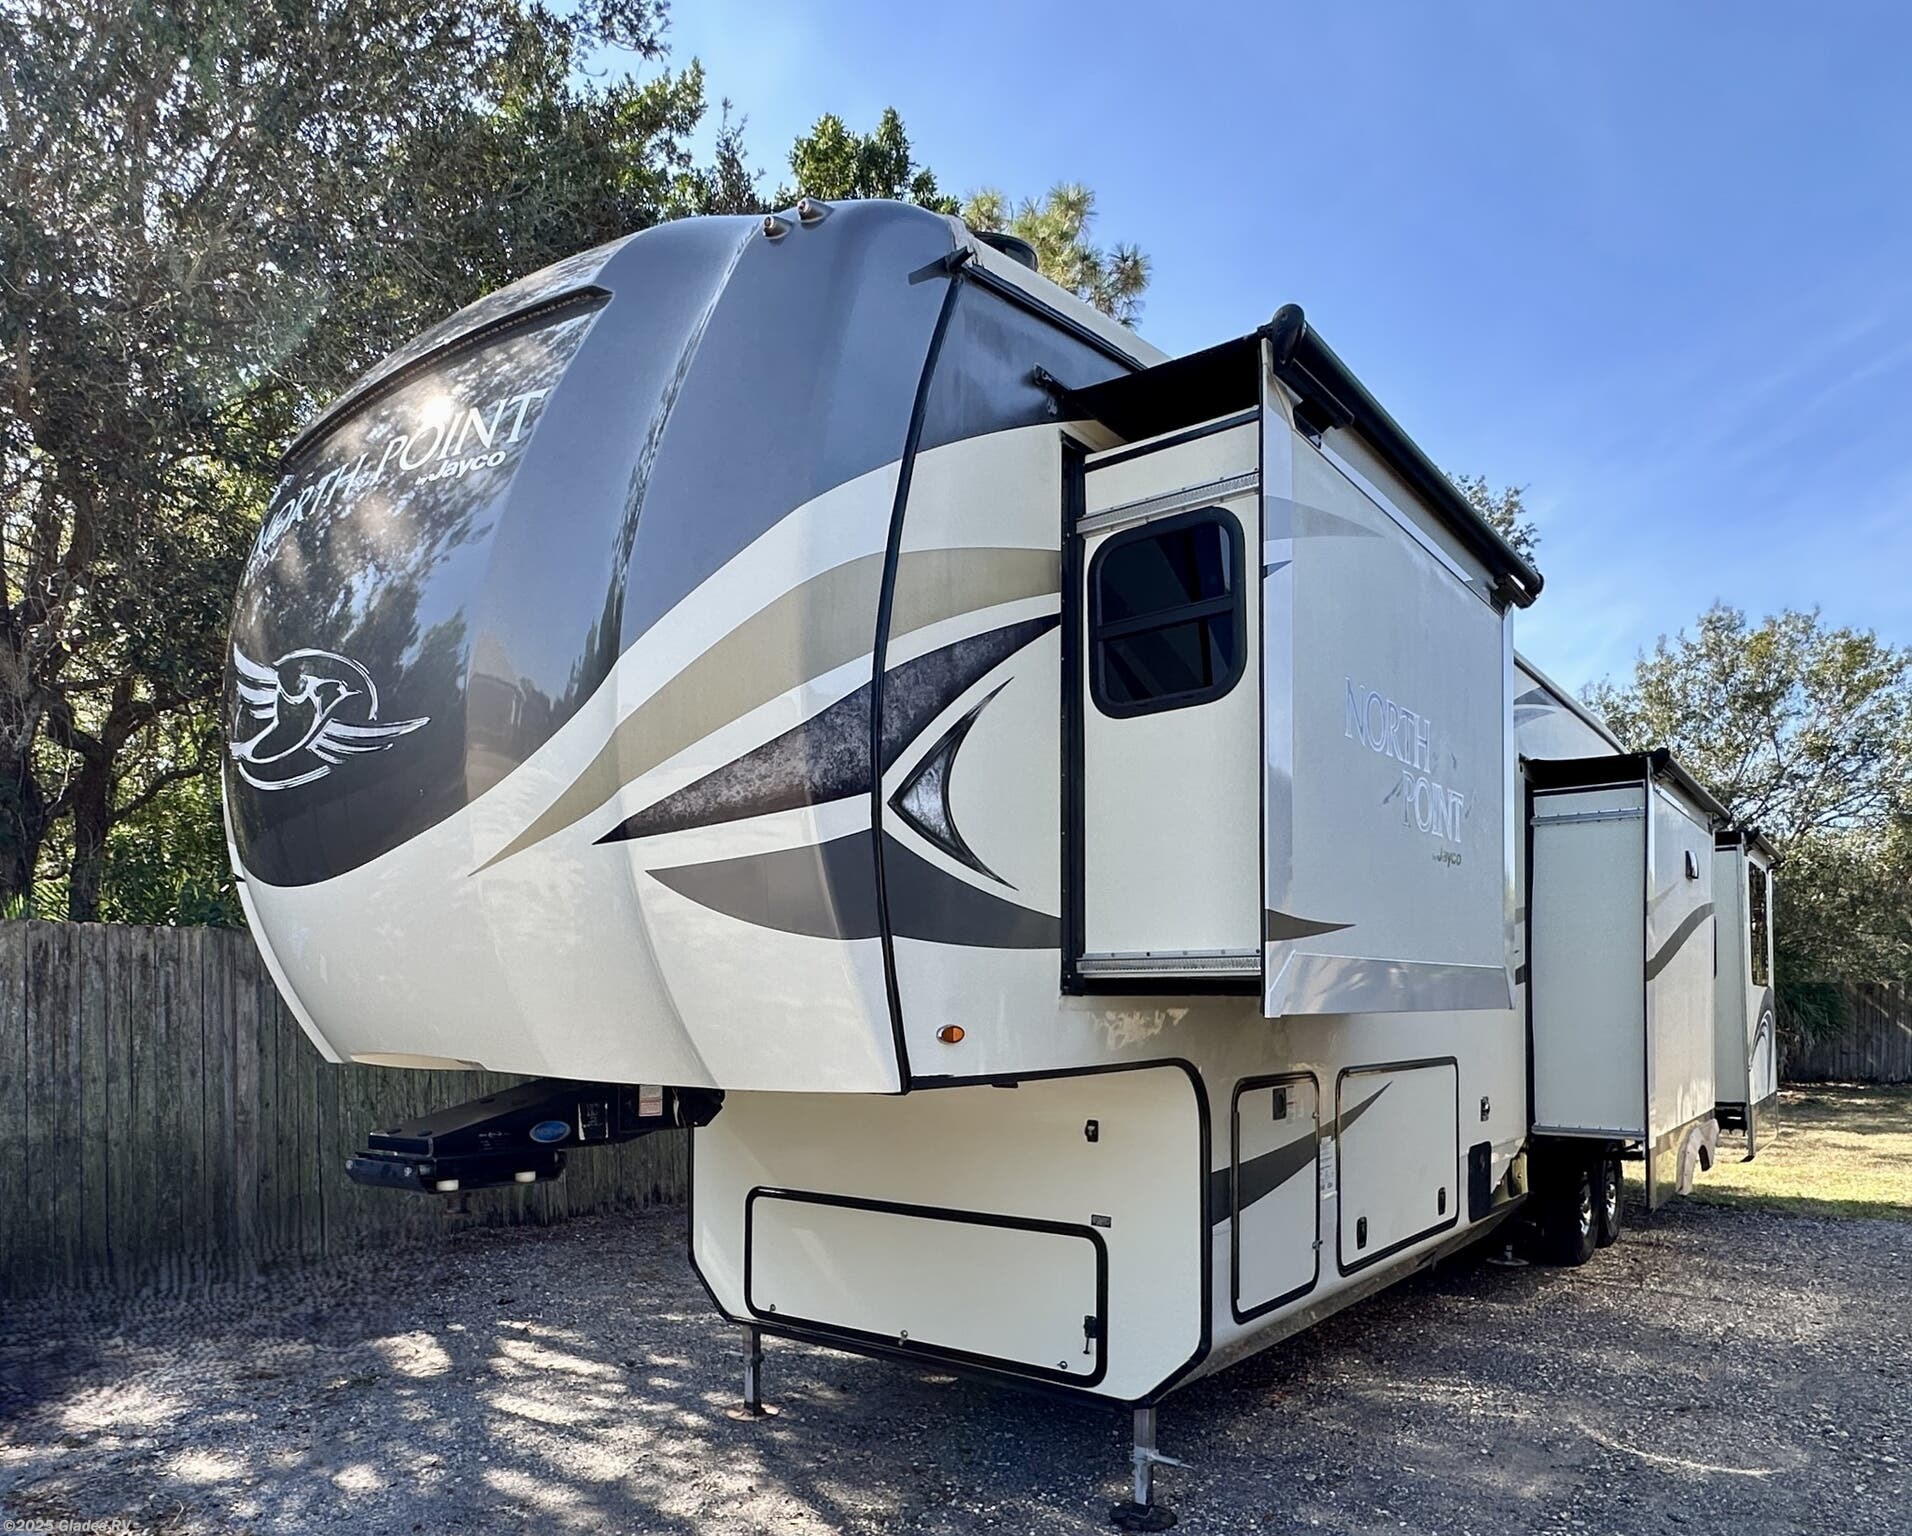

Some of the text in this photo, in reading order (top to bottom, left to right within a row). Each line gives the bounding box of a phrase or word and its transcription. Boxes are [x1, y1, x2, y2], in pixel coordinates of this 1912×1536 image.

[373, 388, 549, 485] POINT
[428, 451, 506, 481] Jayco
[1344, 676, 1431, 774] NORTH
[1401, 769, 1465, 843] POINT
